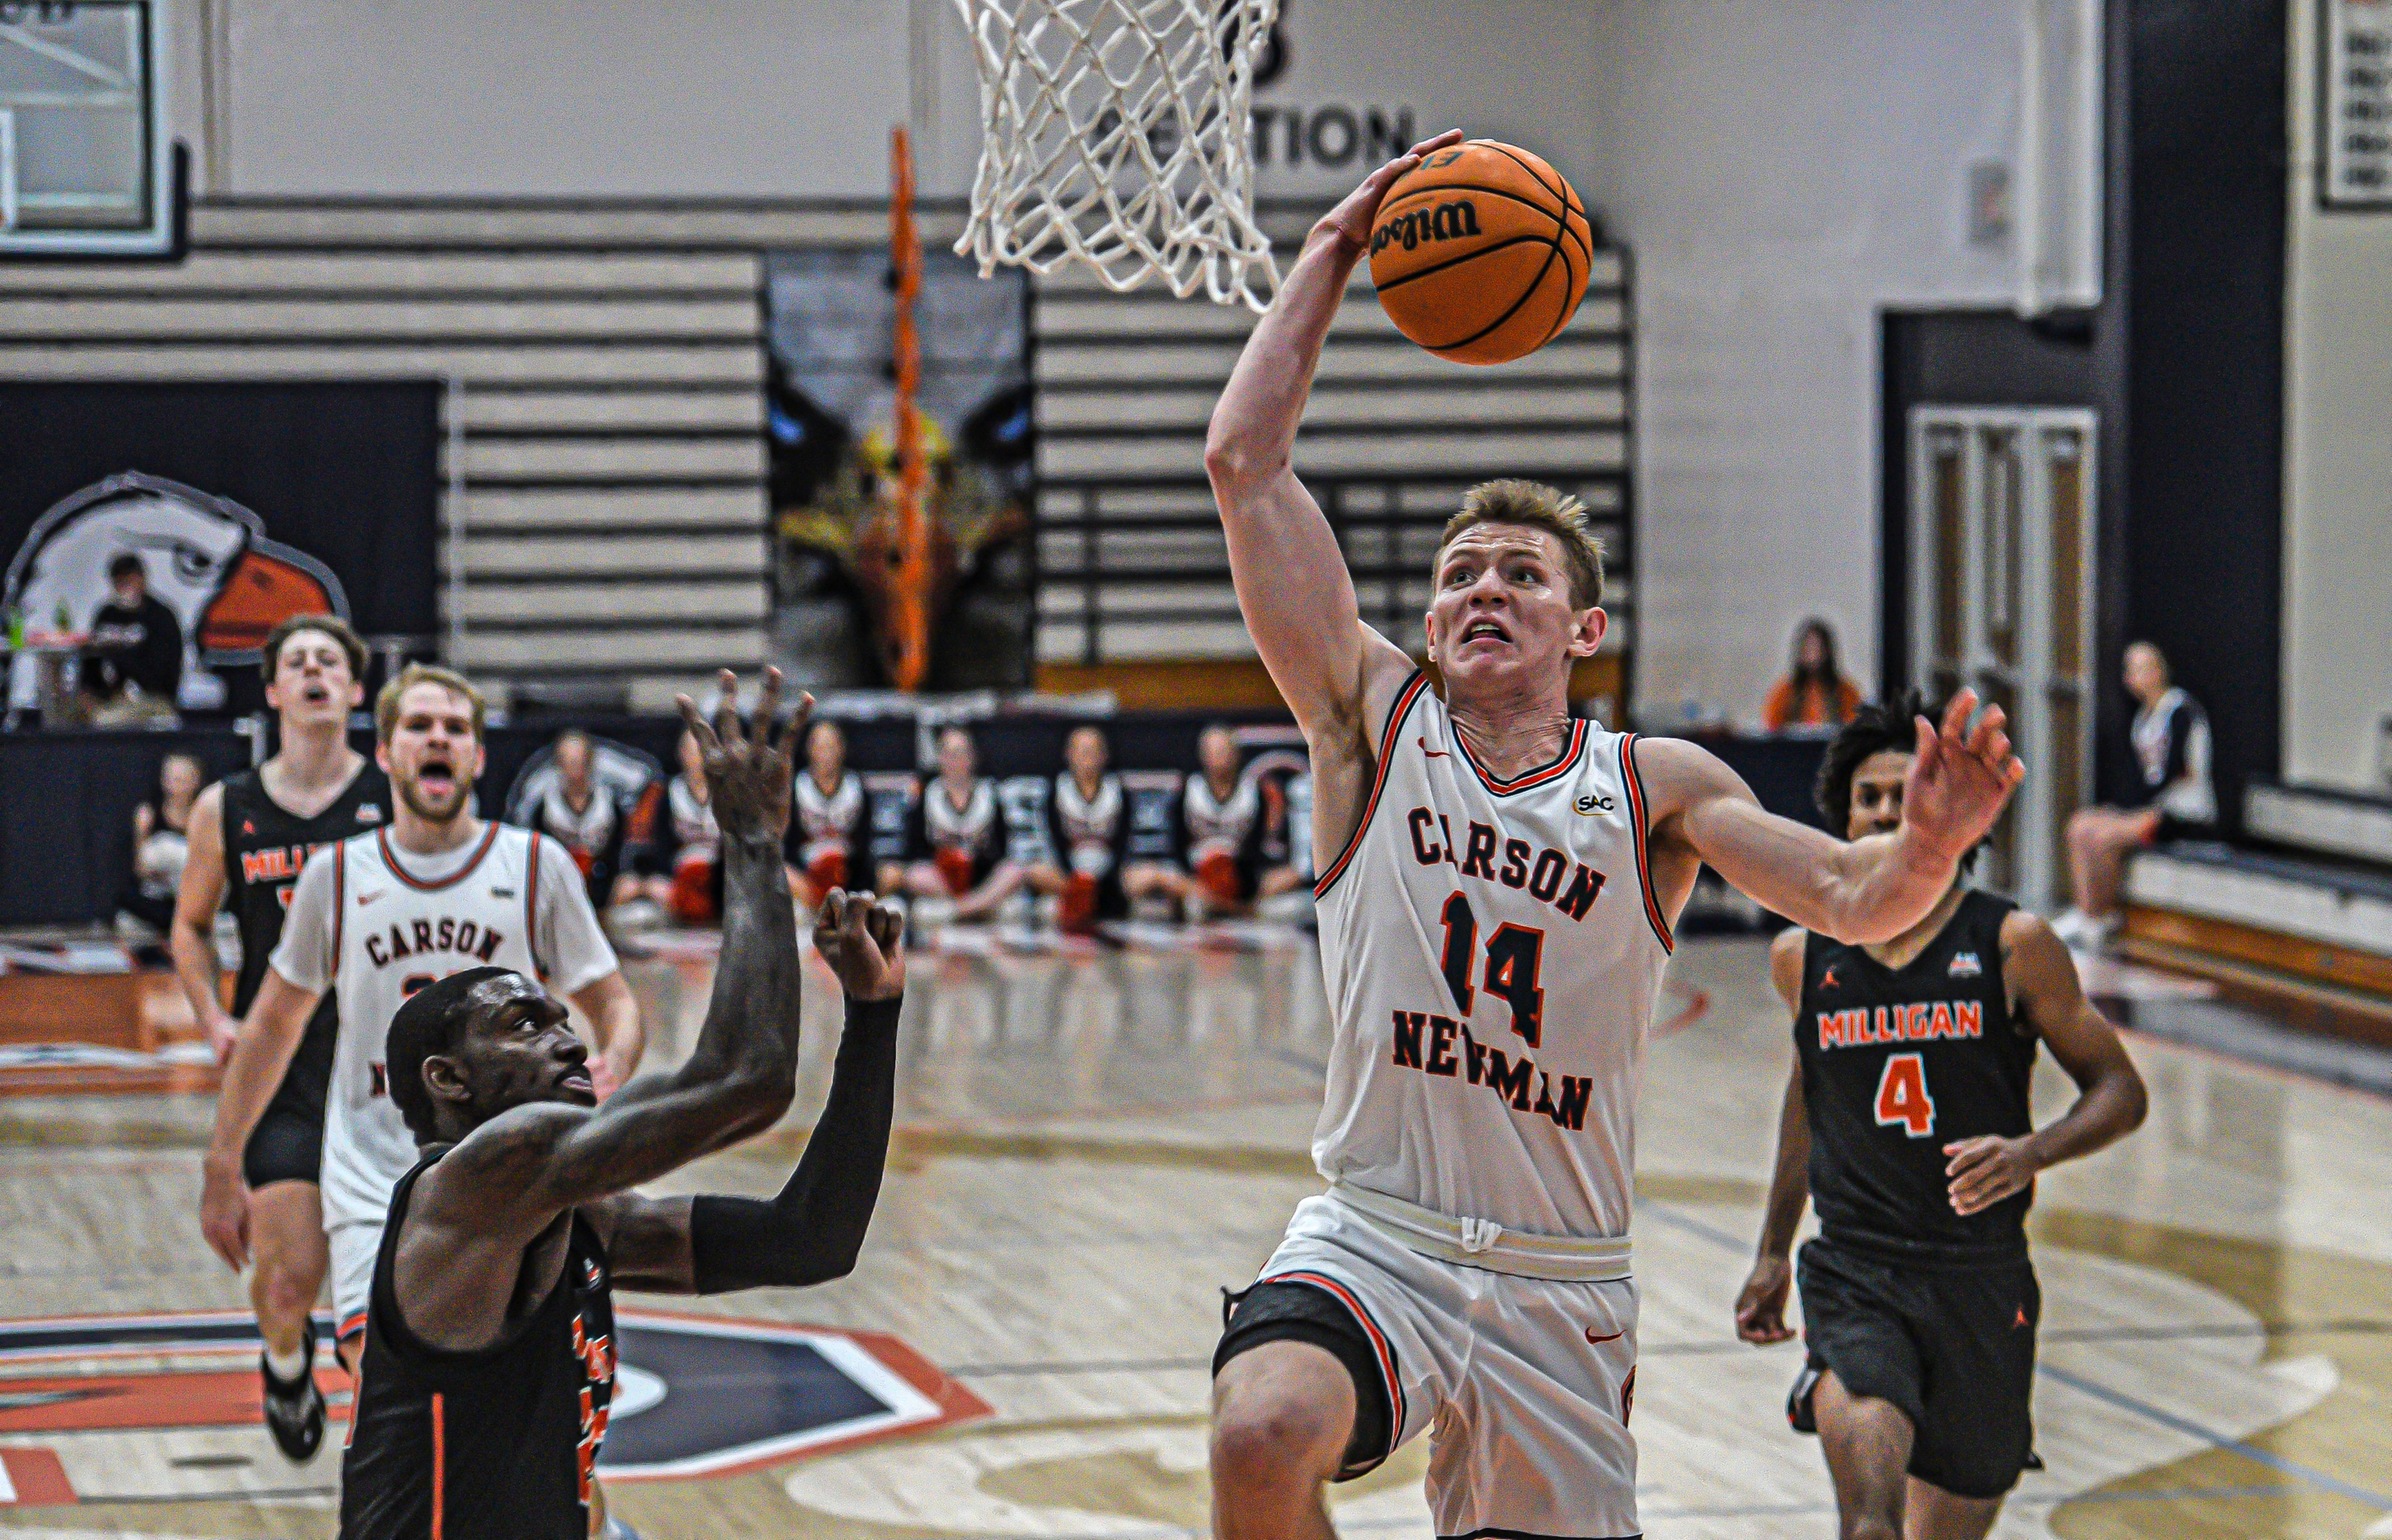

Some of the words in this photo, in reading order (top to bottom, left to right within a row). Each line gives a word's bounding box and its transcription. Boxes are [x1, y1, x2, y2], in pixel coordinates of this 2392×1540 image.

[1577, 794, 1615, 812] SAC
[241, 842, 324, 885] MILL
[365, 917, 504, 967] CARSON
[1439, 889, 1545, 1049] 14
[1816, 999, 1983, 1052] MILLIGAN
[1873, 1050, 1937, 1139] 4
